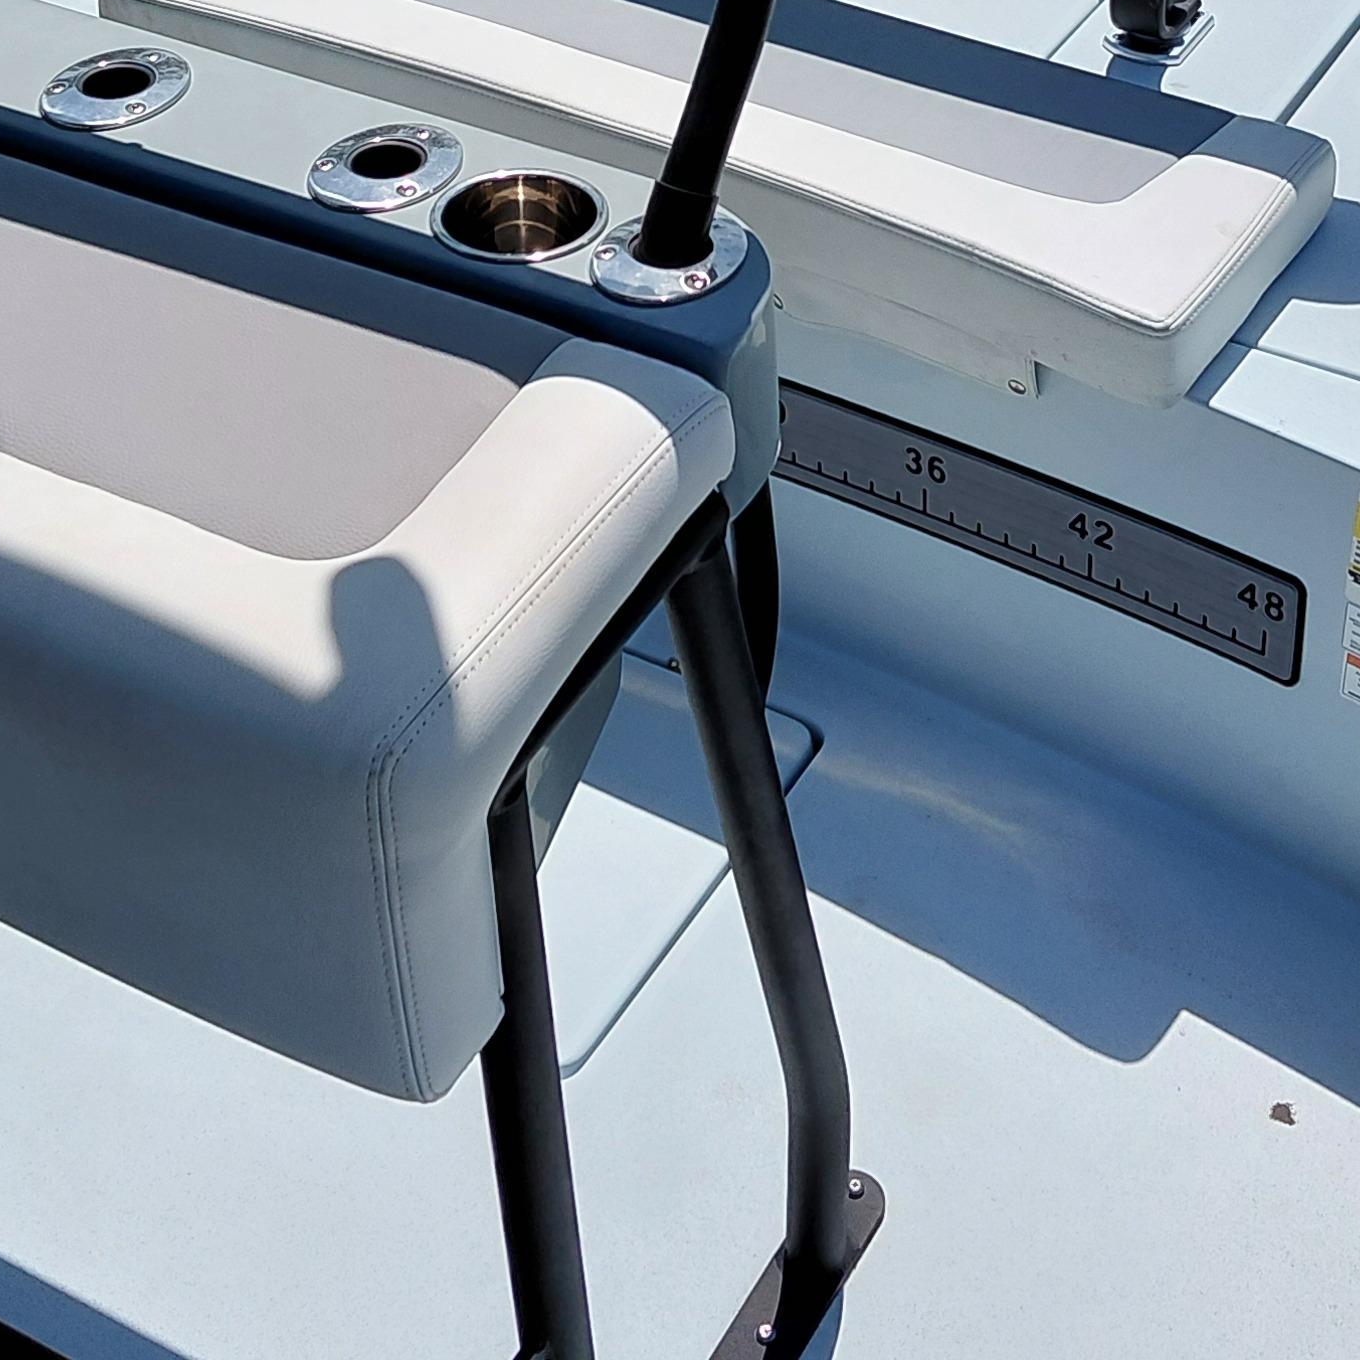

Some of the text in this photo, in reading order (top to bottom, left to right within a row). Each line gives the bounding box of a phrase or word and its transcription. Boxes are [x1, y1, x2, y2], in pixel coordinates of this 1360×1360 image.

[904, 447, 947, 484] 36
[1067, 512, 1116, 552] 42
[1237, 583, 1286, 623] 48
